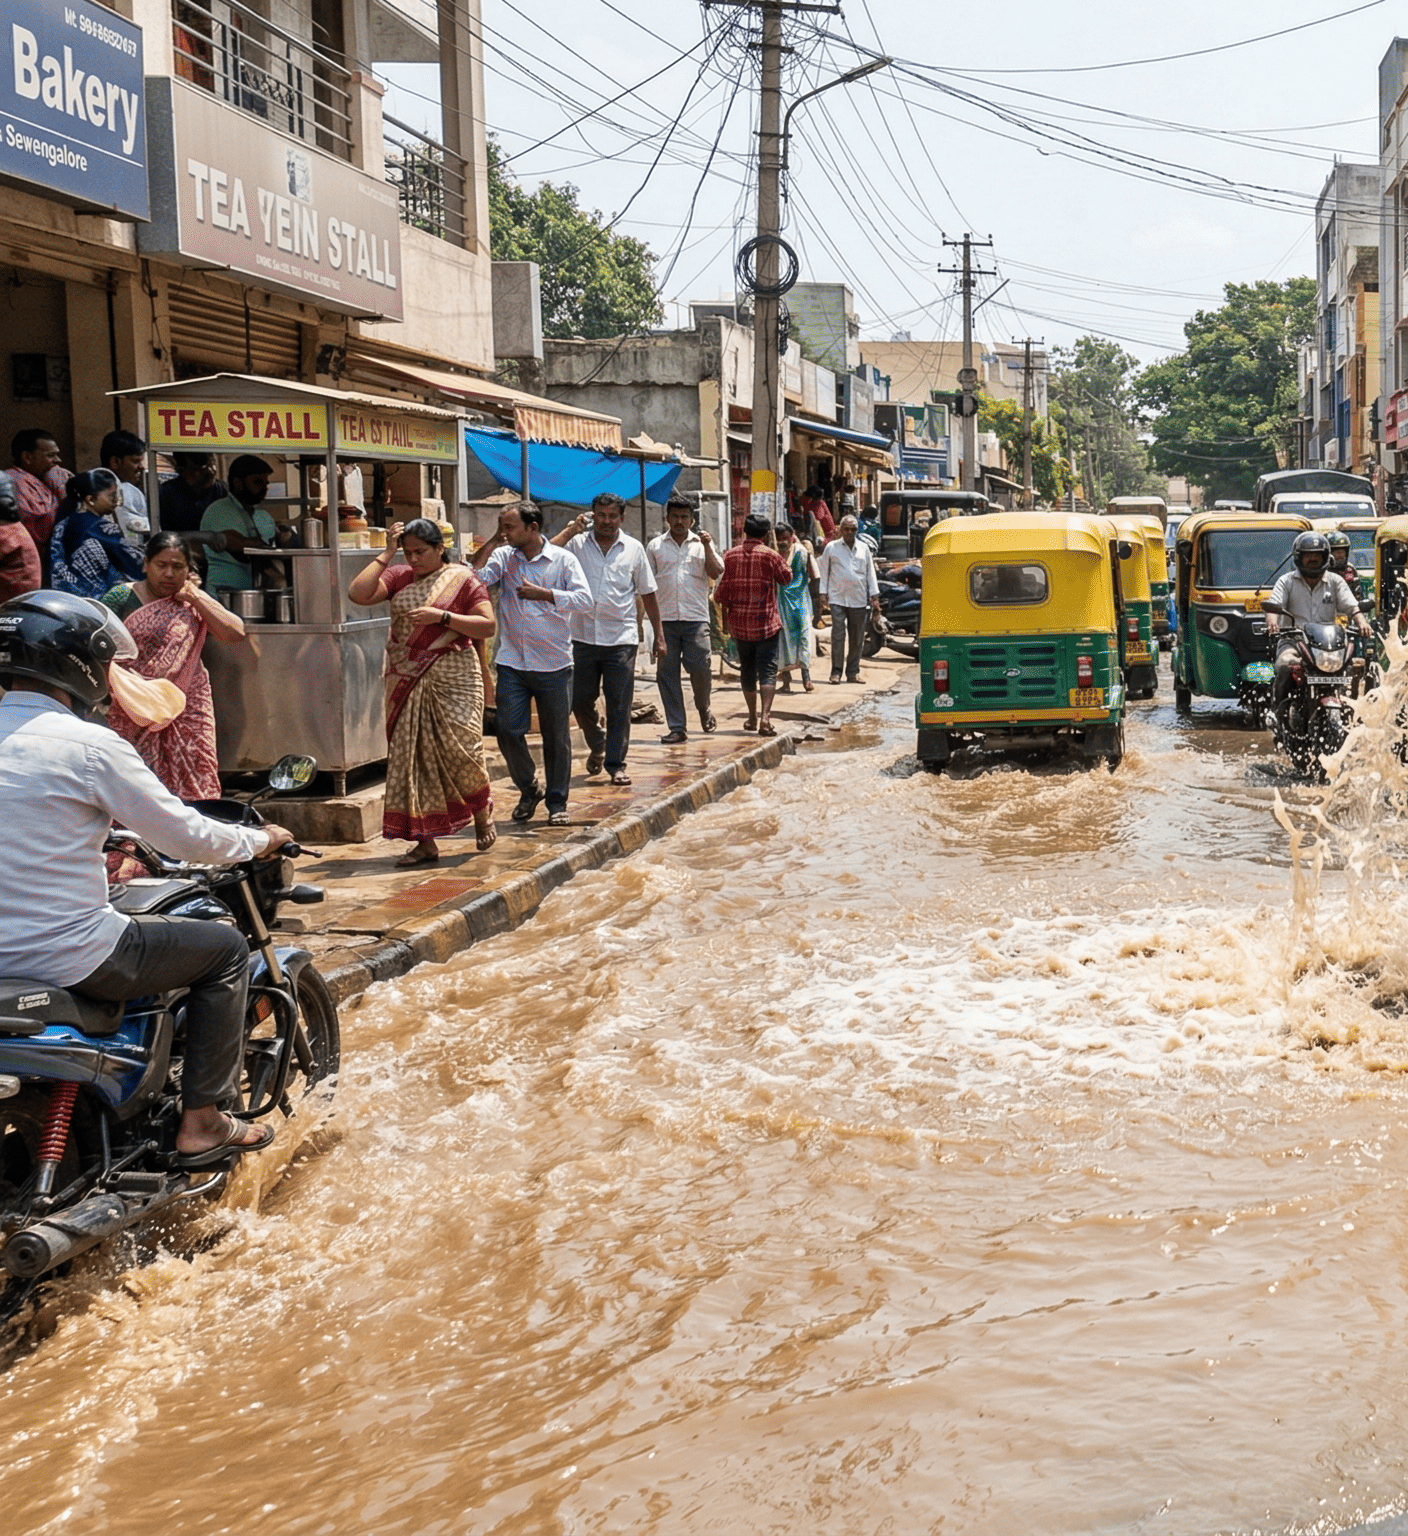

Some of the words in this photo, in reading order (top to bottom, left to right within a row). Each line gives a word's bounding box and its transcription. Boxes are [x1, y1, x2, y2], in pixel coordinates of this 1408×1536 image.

[12, 23, 139, 156] Bakery
[5, 124, 88, 172] Sewengalore
[187, 158, 251, 238] TEA
[327, 217, 397, 289] STALL
[158, 409, 218, 438] TEA
[227, 410, 320, 440] STALL
[340, 414, 367, 443] TEA
